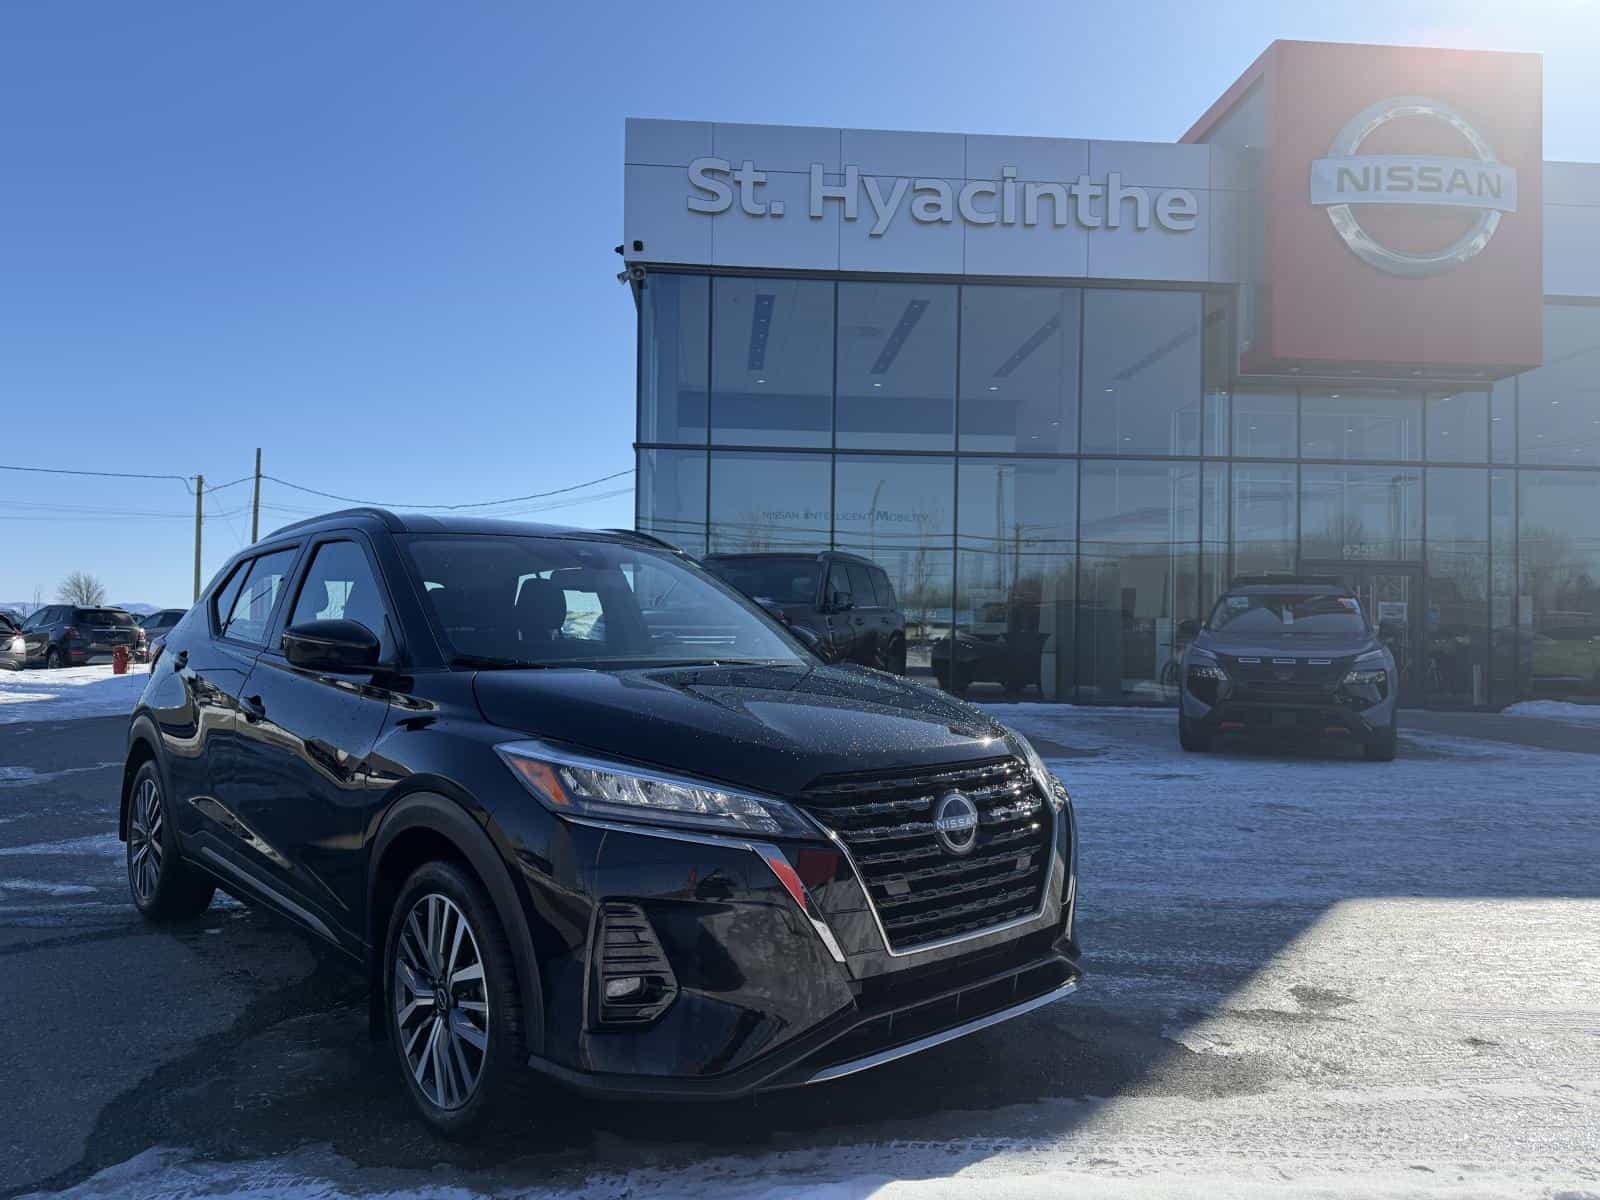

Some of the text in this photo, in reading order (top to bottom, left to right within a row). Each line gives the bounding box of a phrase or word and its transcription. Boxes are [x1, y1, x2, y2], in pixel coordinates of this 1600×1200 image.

[686, 157, 1199, 239] St. Hyacinthe
[1336, 165, 1504, 199] NISSAN
[936, 815, 977, 830] NISSAN
